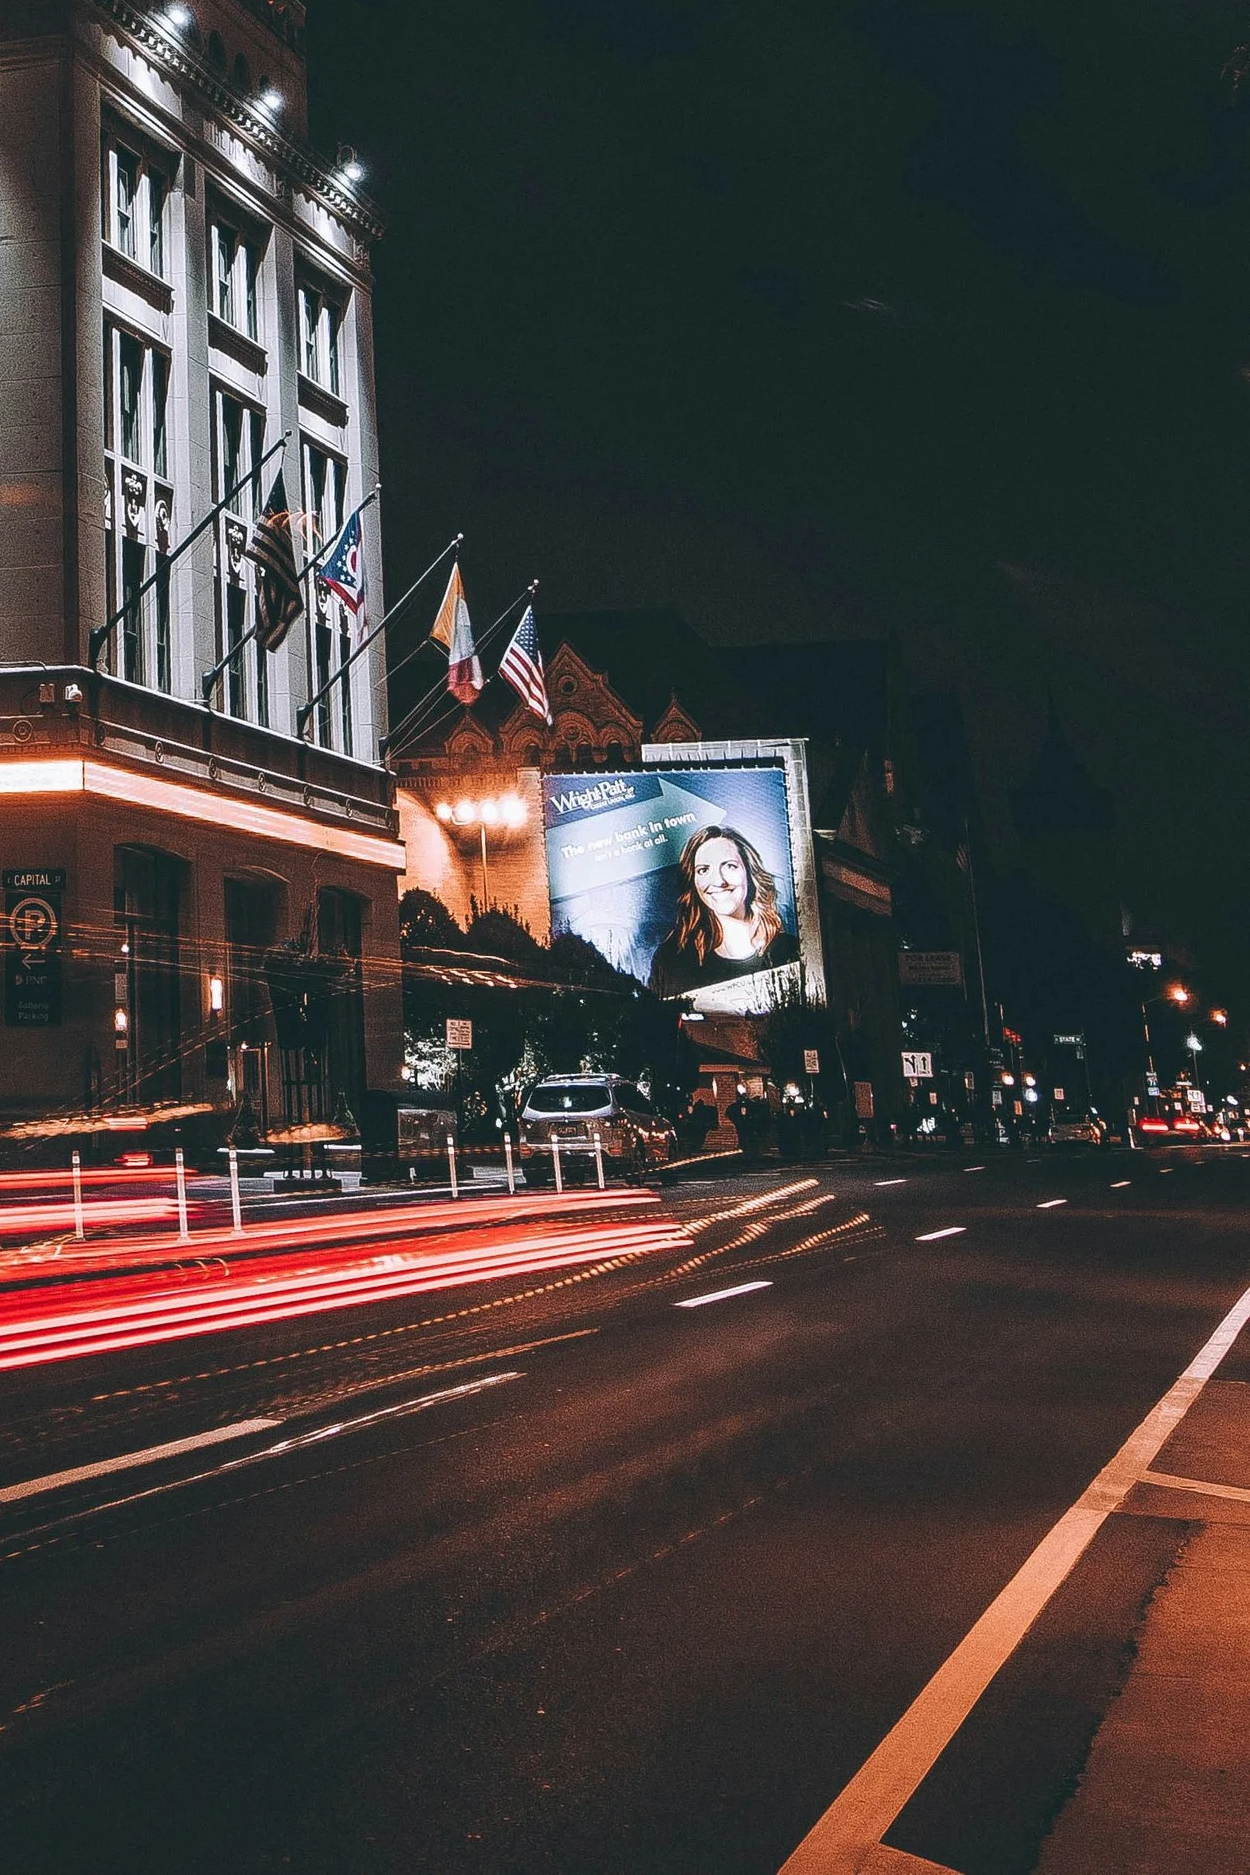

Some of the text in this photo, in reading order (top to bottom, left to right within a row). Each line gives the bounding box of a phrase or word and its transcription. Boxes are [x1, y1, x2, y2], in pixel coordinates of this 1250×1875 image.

[561, 813, 697, 859] The new bank in town
[620, 840, 644, 854] bank
[643, 838, 654, 849] at
[654, 833, 669, 845] all.
[13, 873, 52, 886] CAPITAL
